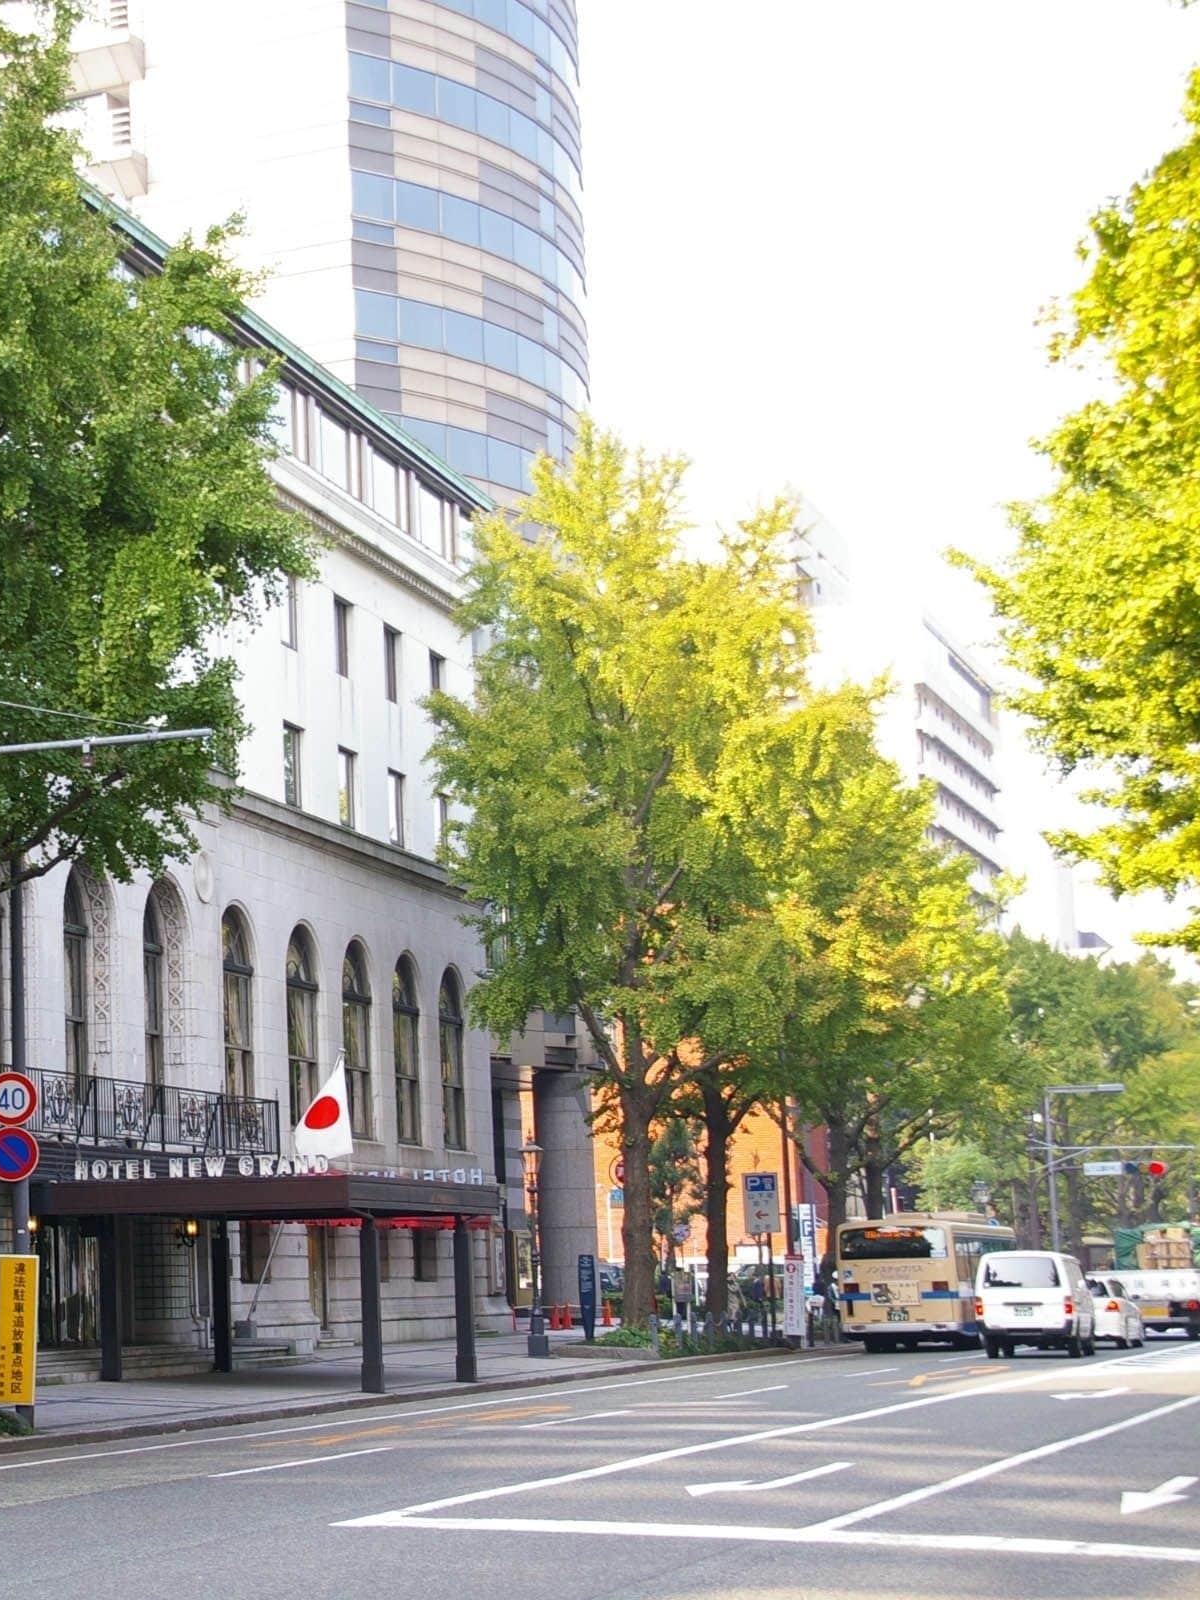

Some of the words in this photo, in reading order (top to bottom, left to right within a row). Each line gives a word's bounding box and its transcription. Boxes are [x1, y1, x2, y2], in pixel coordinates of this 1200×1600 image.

[74, 1159, 157, 1181] HOTEL
[169, 1156, 226, 1178] NEW
[238, 1153, 329, 1177] GRAND
[10, 1262, 26, 1394] 違法駐車追放重点地区
